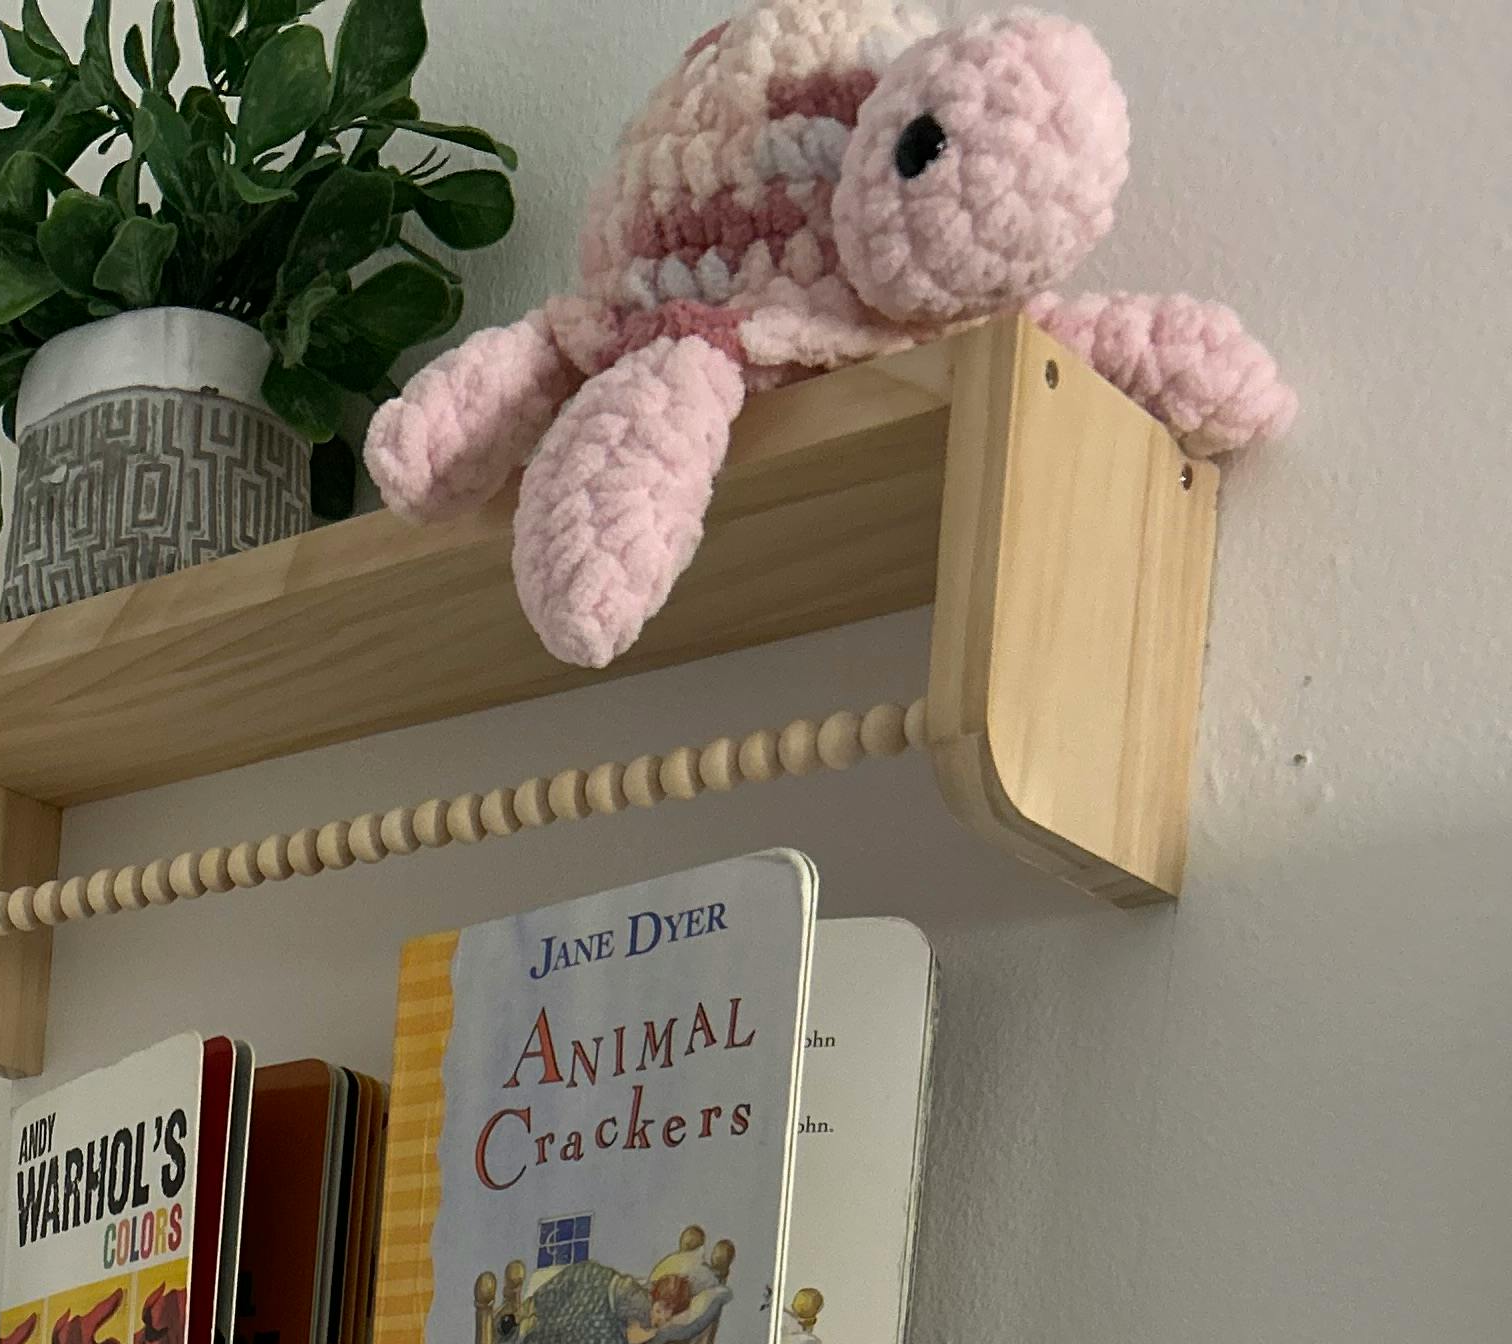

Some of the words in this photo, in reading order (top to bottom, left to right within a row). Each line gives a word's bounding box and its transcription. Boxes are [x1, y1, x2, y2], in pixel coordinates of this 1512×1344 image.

[529, 928, 614, 980] JANE
[624, 900, 729, 960] DYER
[502, 996, 756, 1089] ANIMAL
[16, 1106, 188, 1249] WARHOL'S
[18, 1111, 58, 1164] ANDY
[474, 1085, 754, 1191] Crackers
[103, 1203, 183, 1271] COLORS
